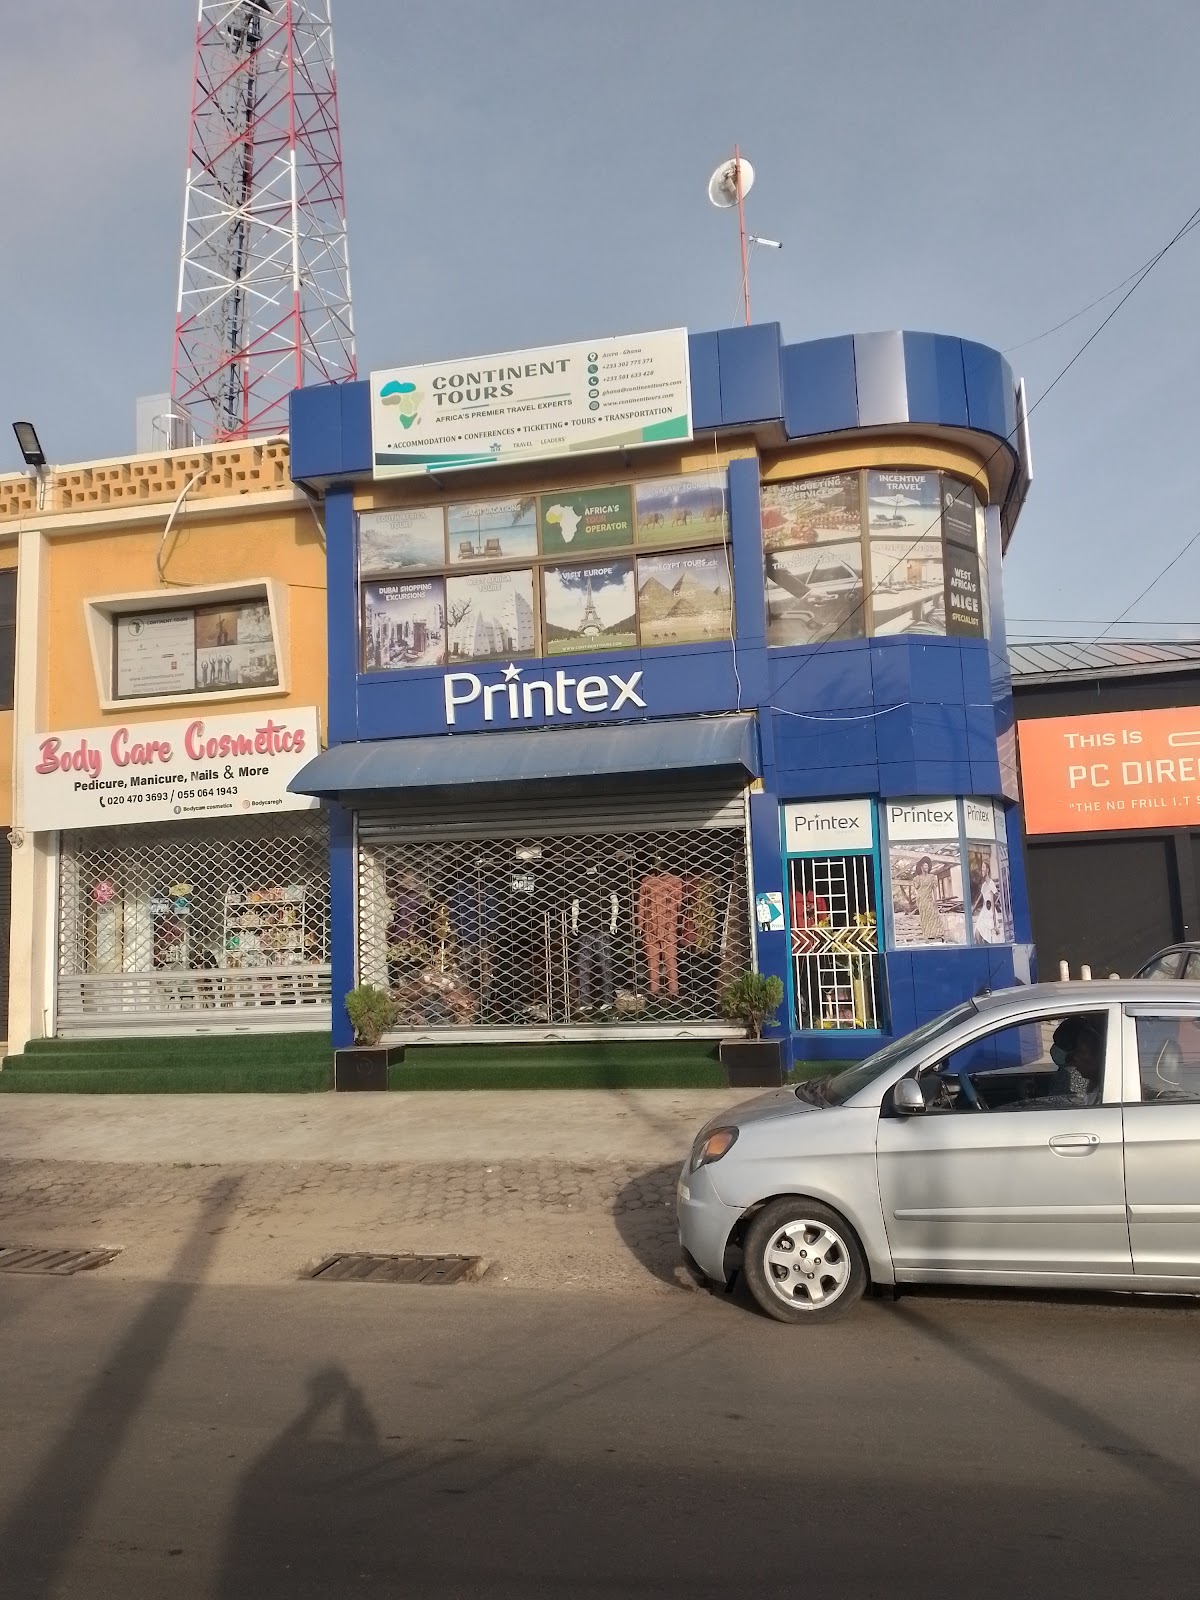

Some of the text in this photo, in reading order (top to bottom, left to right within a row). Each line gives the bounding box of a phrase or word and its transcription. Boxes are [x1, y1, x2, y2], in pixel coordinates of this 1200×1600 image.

[432, 359, 570, 390] CONTINENT
[433, 383, 514, 406] TOURS
[435, 399, 573, 424] AFRICA'S PREMIER TRAVEL EXPERTS
[393, 406, 673, 450] ACCOMMODATION CONFERENCES TICKETING TOURS TRANSPORTATION
[780, 478, 841, 493] BANQUETING
[880, 474, 926, 483] INCENTIVE
[886, 482, 922, 490] TRAVEL
[400, 511, 427, 521] AFRICA
[484, 504, 521, 516] VACATIONS
[584, 504, 620, 515] AFRICA'S
[585, 514, 607, 524] TOUR
[585, 521, 627, 534] OPERATOR
[658, 561, 680, 570] EGYPT
[486, 575, 511, 584] AFRICA
[562, 567, 613, 580] VISIT EUROPE
[954, 567, 971, 580] WEST
[379, 583, 432, 595] DUBAI SHOPPING
[951, 577, 977, 592] AFRICA'S
[385, 591, 426, 601] EXCURSIONS
[951, 592, 979, 613] MICE
[952, 612, 979, 626] SPECIALIST
[444, 662, 648, 725] Printex
[35, 719, 307, 779] Body Care Cosmetics
[74, 765, 270, 792] Pedicure, Manicure, Nails & More
[1068, 757, 1200, 789] PC DIRE
[107, 796, 124, 806] 020
[126, 793, 143, 804] 470
[145, 791, 168, 802] 3693
[177, 789, 195, 800] 055
[197, 788, 214, 798] 064
[216, 785, 238, 797] 1943
[1106, 801, 1125, 810] NO
[1131, 797, 1167, 809] FRILL
[891, 805, 955, 823] Printex
[967, 804, 989, 822] Printex
[794, 814, 860, 832] Printex
